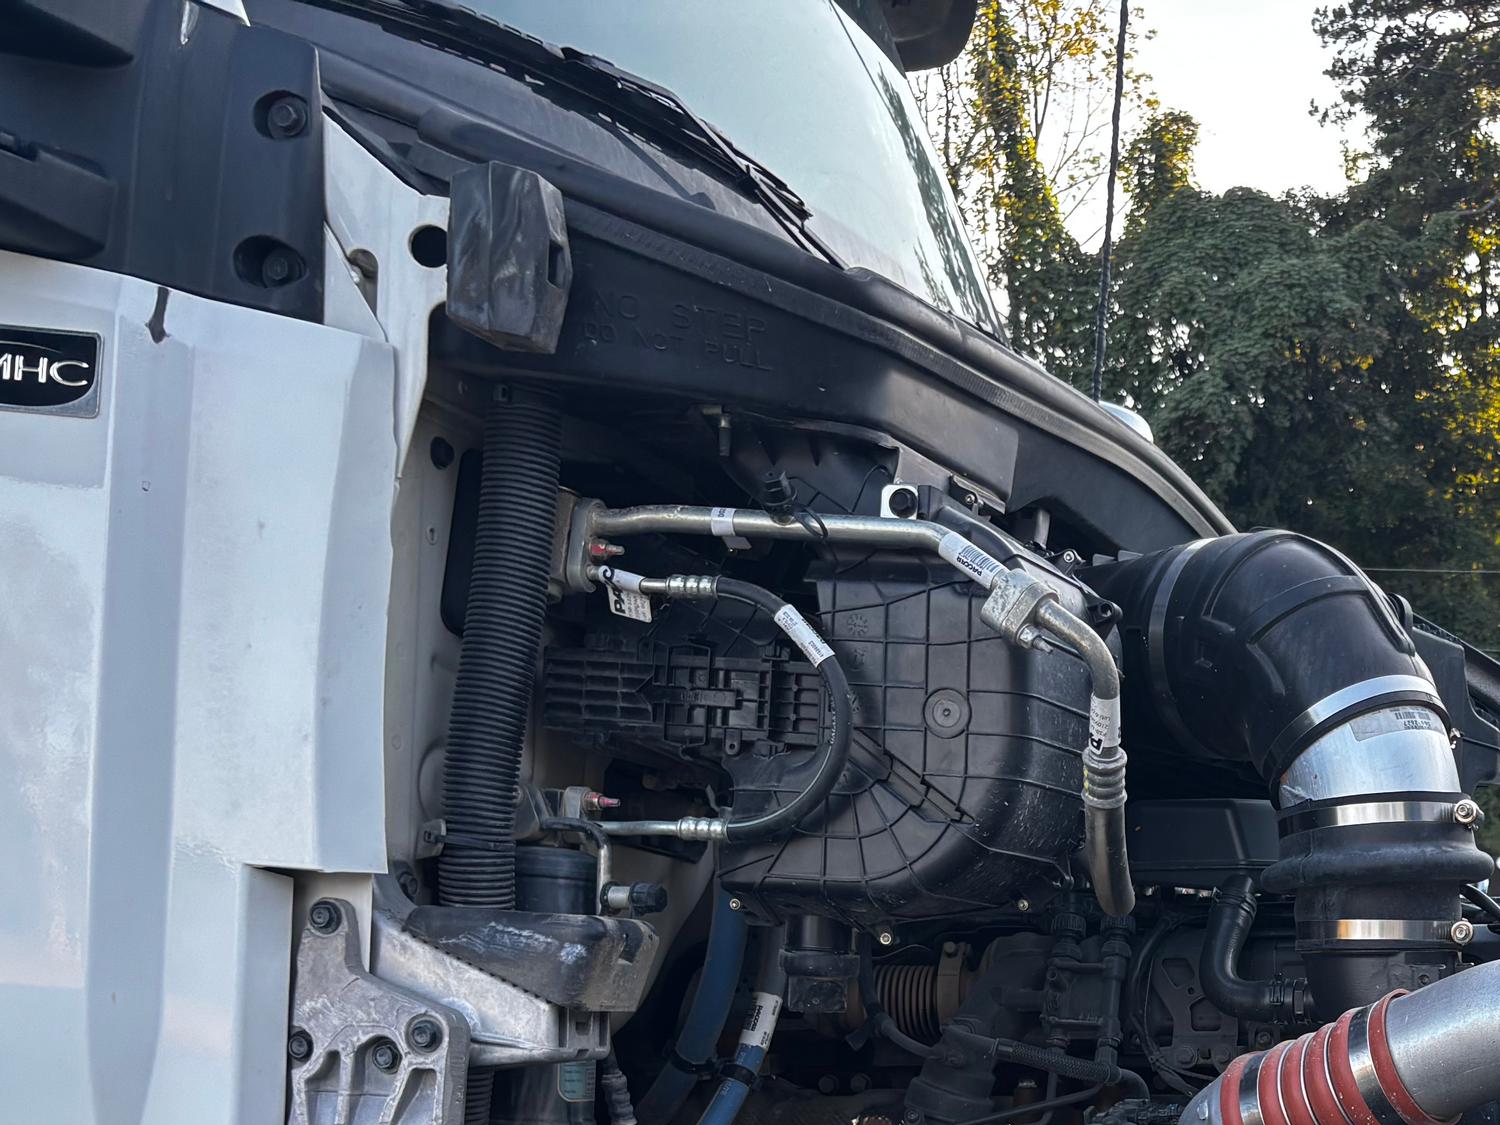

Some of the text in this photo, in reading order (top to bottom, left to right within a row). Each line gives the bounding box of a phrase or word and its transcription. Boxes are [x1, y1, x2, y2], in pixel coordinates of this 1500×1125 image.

[593, 291, 768, 343] NO STEP
[702, 340, 773, 371] PULL
[956, 555, 983, 577] PACCAR
